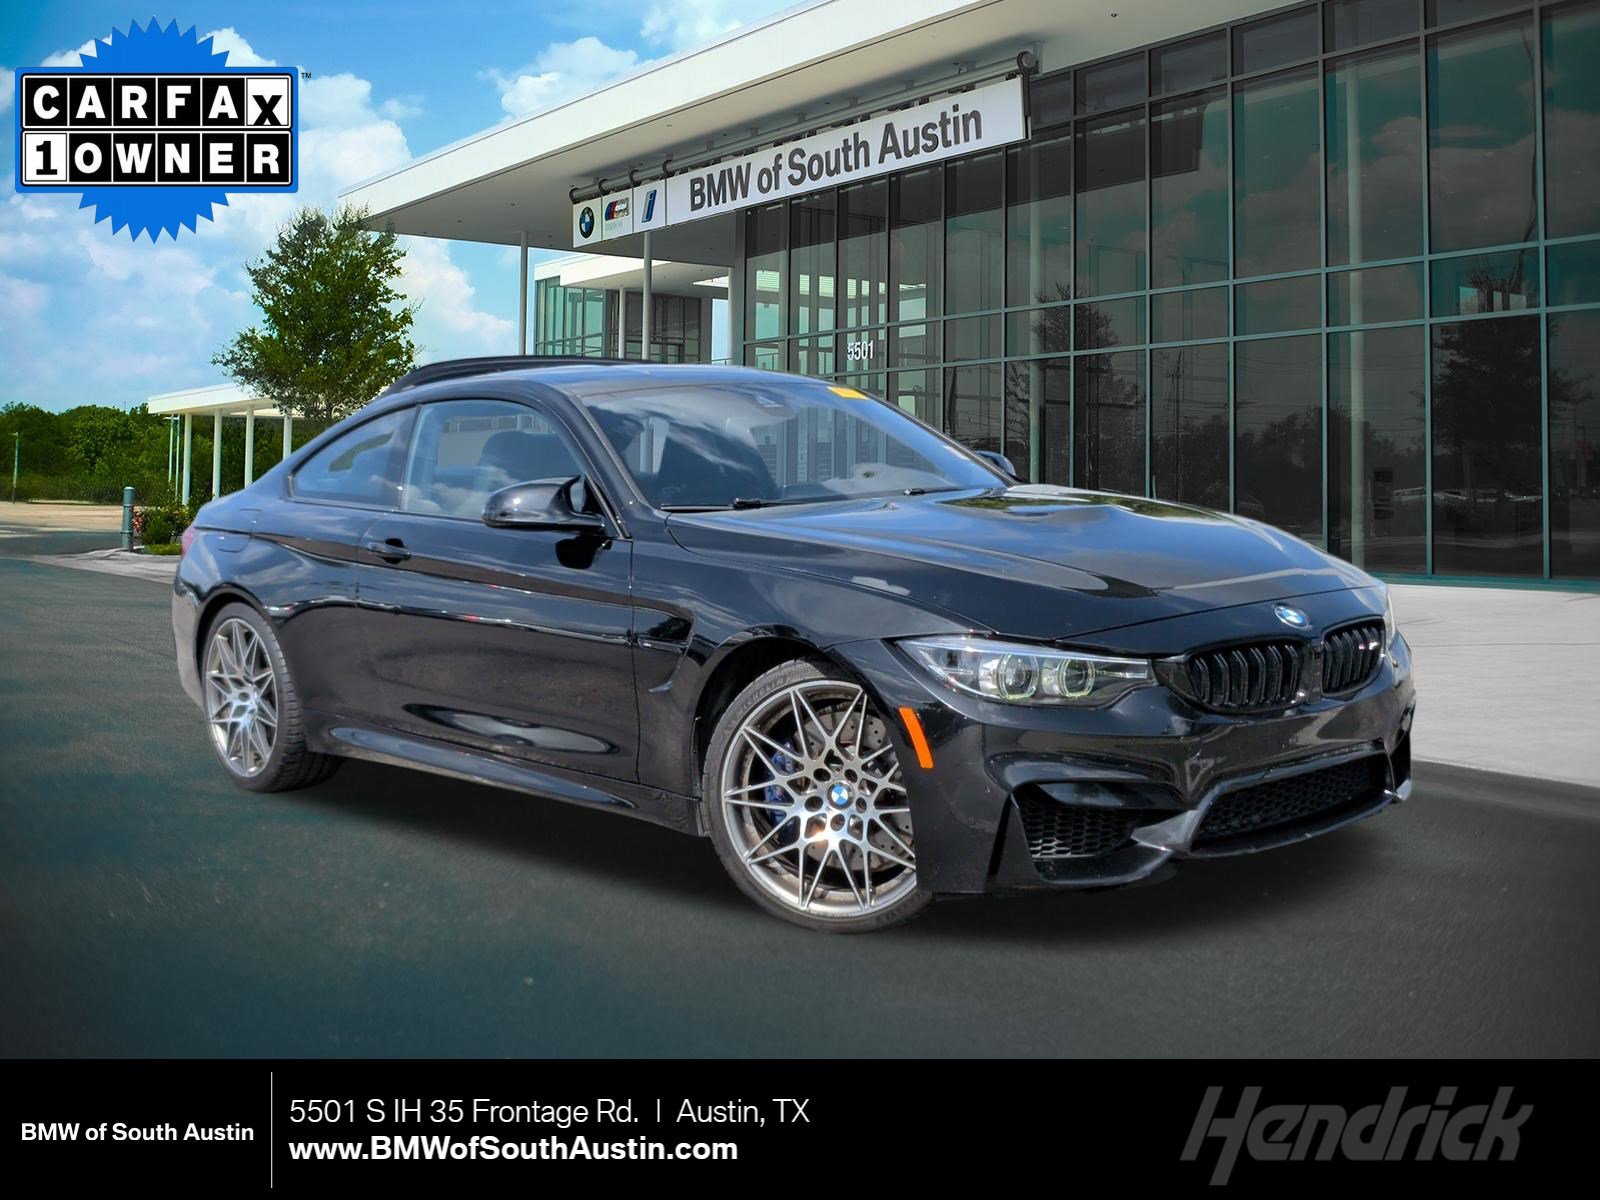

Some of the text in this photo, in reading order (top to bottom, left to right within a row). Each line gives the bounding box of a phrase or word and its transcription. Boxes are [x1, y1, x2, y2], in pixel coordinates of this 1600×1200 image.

[689, 161, 752, 212] BMW
[757, 152, 783, 195] of
[787, 131, 871, 187] South
[877, 103, 983, 165] Austin
[846, 340, 874, 361] 5501
